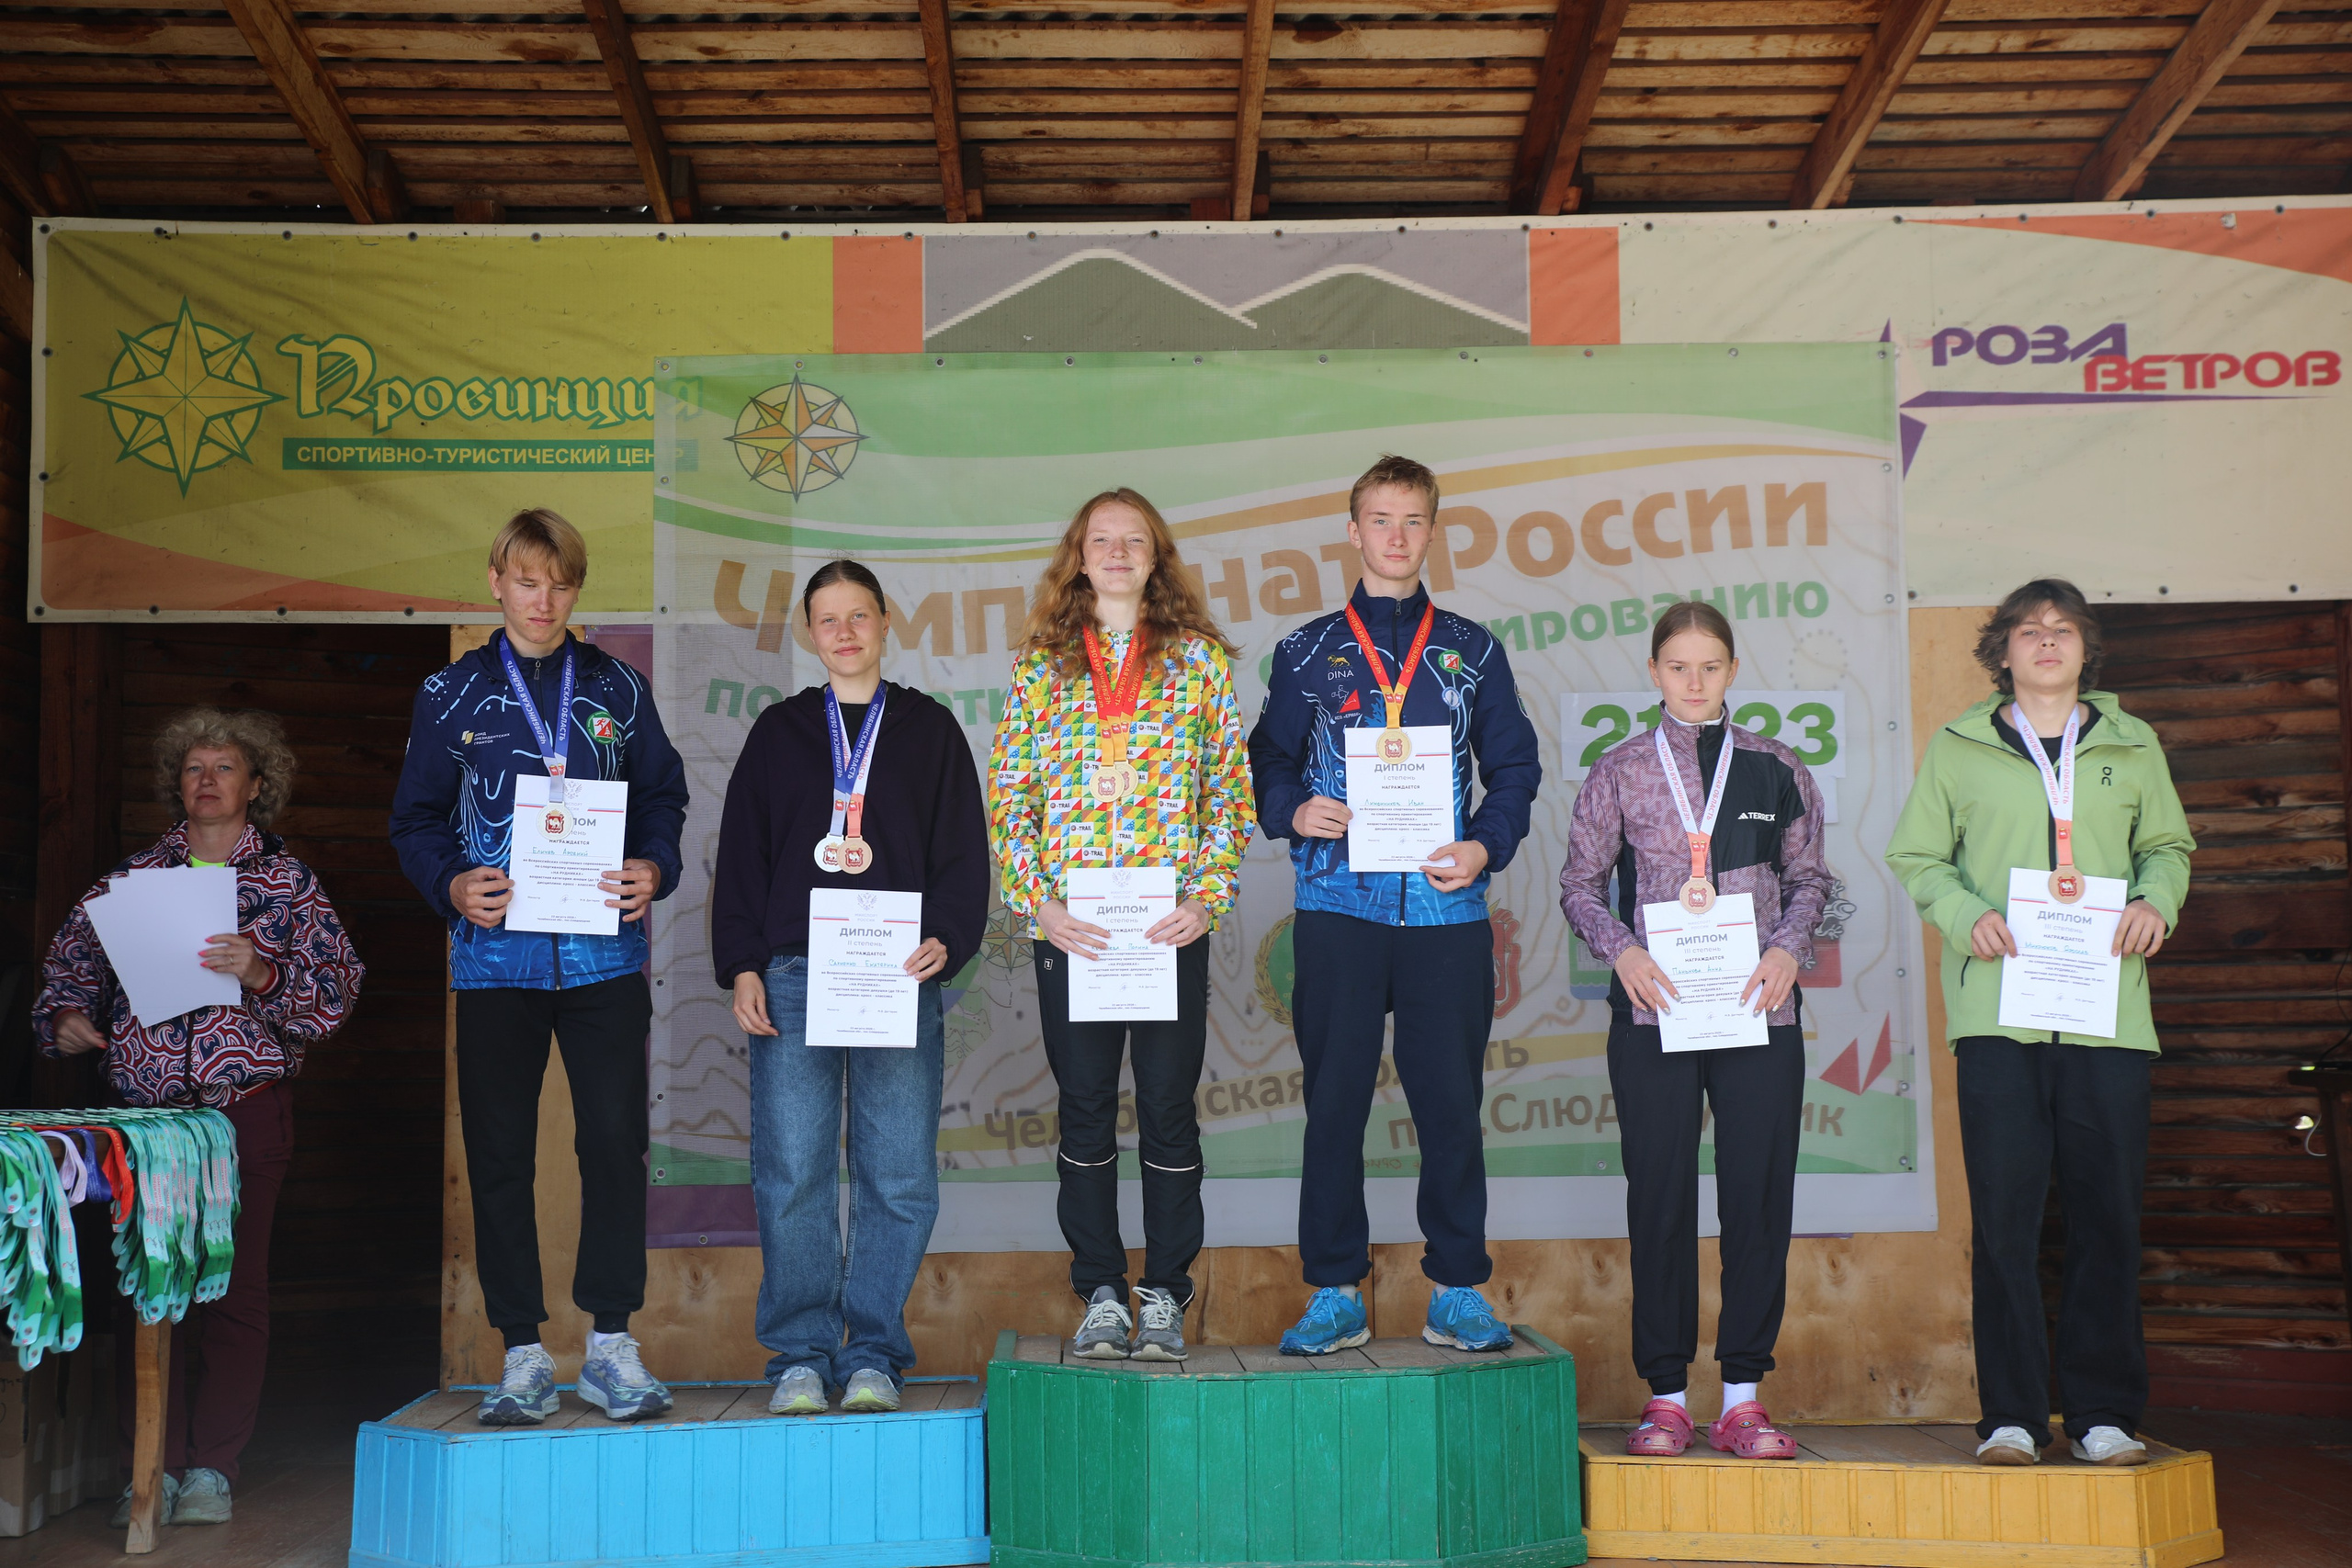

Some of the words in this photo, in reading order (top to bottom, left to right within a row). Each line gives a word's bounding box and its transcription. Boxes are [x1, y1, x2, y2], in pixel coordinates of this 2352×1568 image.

[1932, 322, 2127, 367] РОЗА
[2084, 350, 2342, 393] ВЕТРОВ
[297, 445, 610, 465] СПОРТИВНО-ТУРИСТИЧЕСКИЙ
[1427, 480, 1827, 593] России
[507, 660, 525, 693] ОБЛАСТЬ
[562, 655, 572, 705] ЧЕЛЯБИНСКАЯ
[1328, 670, 1354, 681] DINA
[522, 694, 547, 745] ЧЕЛЯБИНСКАЯ
[559, 705, 569, 741] ОБЛАСТЬ
[830, 701, 838, 728] ОБЛАСТЬ
[831, 728, 842, 778] ЧЕЛЯБИНСКАЯ
[847, 749, 862, 780] ОБЛАСТЬ
[1374, 763, 1425, 773] ДИПЛОМ
[1660, 742, 1674, 773] ОБЛАСТЬ
[1670, 773, 1690, 821] ЧЕЛЯБИНСКАЯ
[1706, 789, 1719, 820] ОБЛАСТЬ
[1747, 812, 1776, 822] TERREX
[1097, 906, 1148, 915] ДИПЛОМ
[2037, 911, 2092, 924] ДИПЛОМ
[840, 928, 892, 937] ДИПЛОМ
[1676, 933, 1727, 946] ДИПЛОМ
[2043, 934, 2085, 942] НАГРАЖДАЕТСЯ
